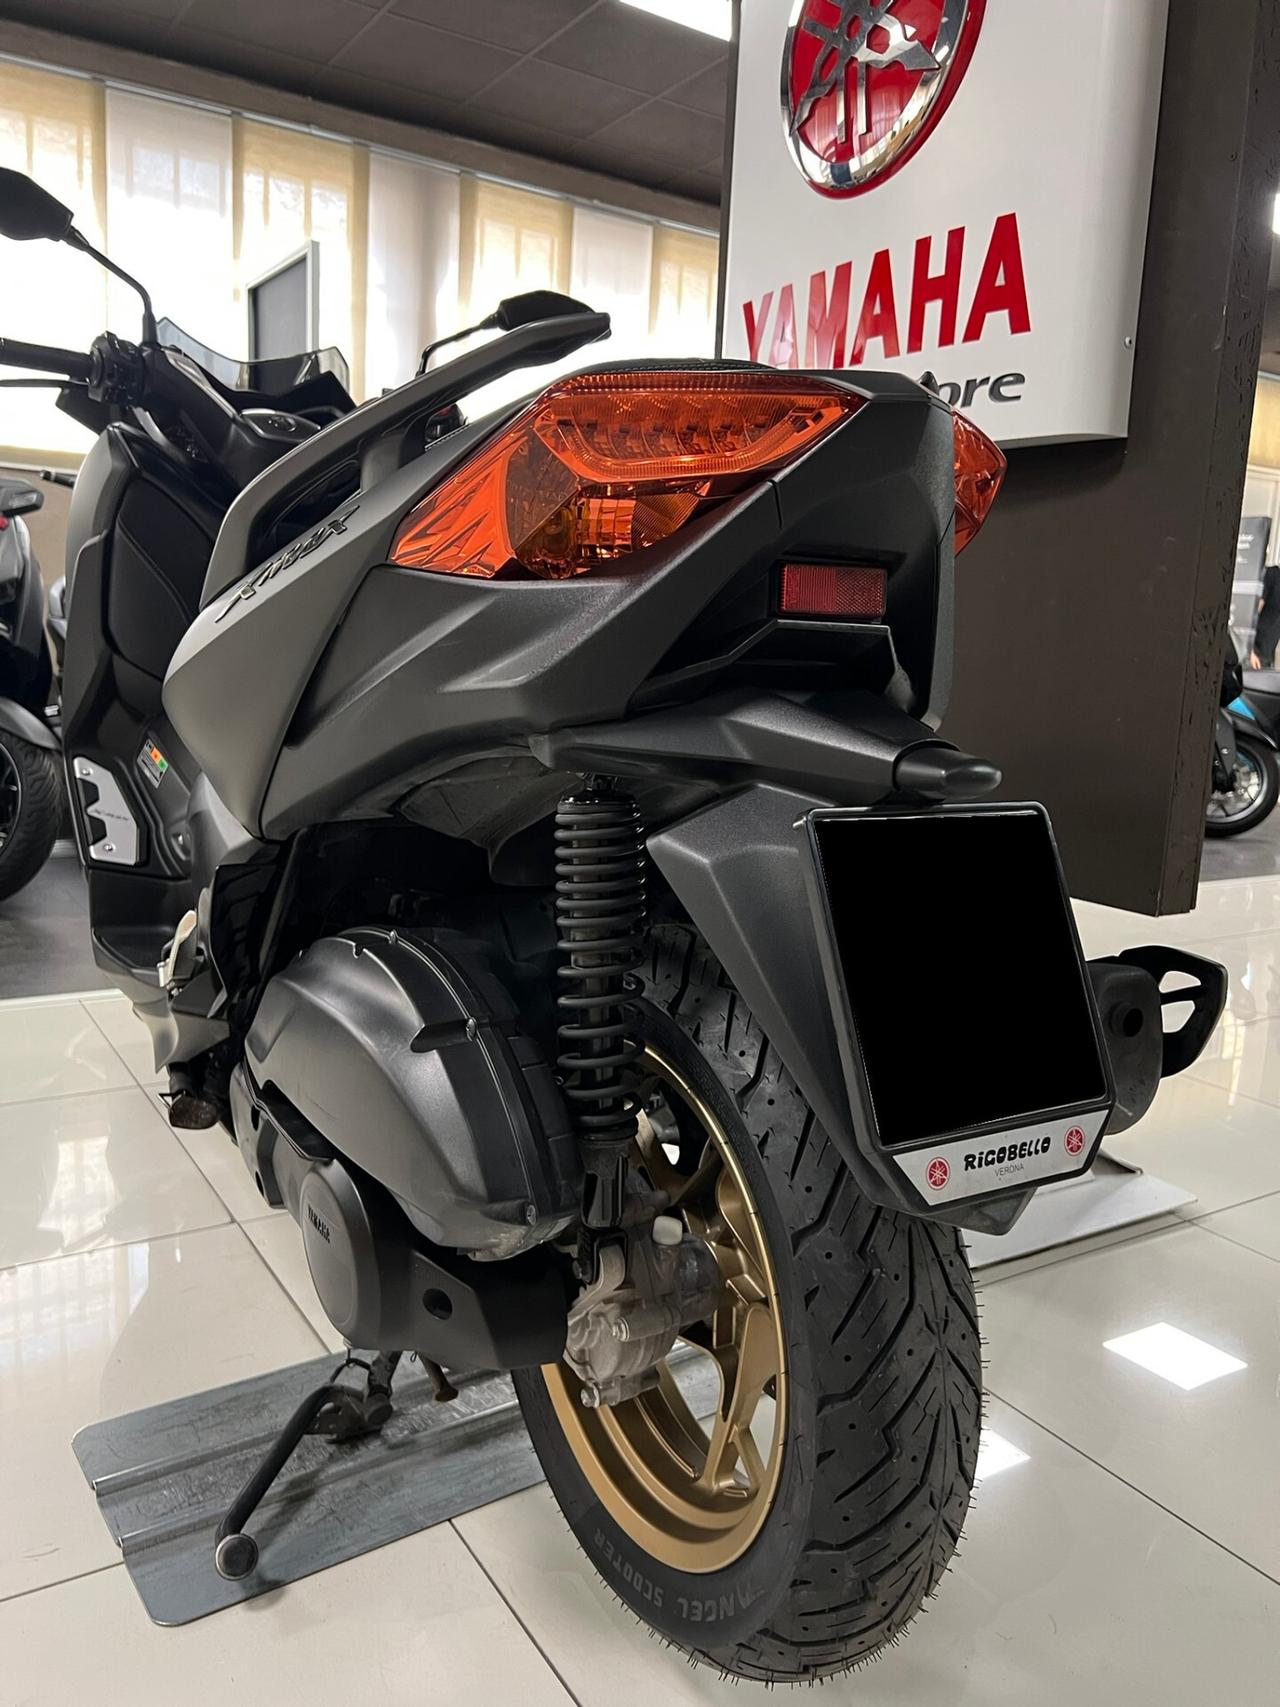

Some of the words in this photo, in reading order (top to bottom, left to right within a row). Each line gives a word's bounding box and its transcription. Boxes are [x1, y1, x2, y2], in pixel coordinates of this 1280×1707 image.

[742, 212, 1031, 369] YAMAHA
[994, 1163, 1025, 1177] VERONA
[593, 1528, 664, 1608] SCOOTER
[677, 1581, 769, 1622] ANGEL
